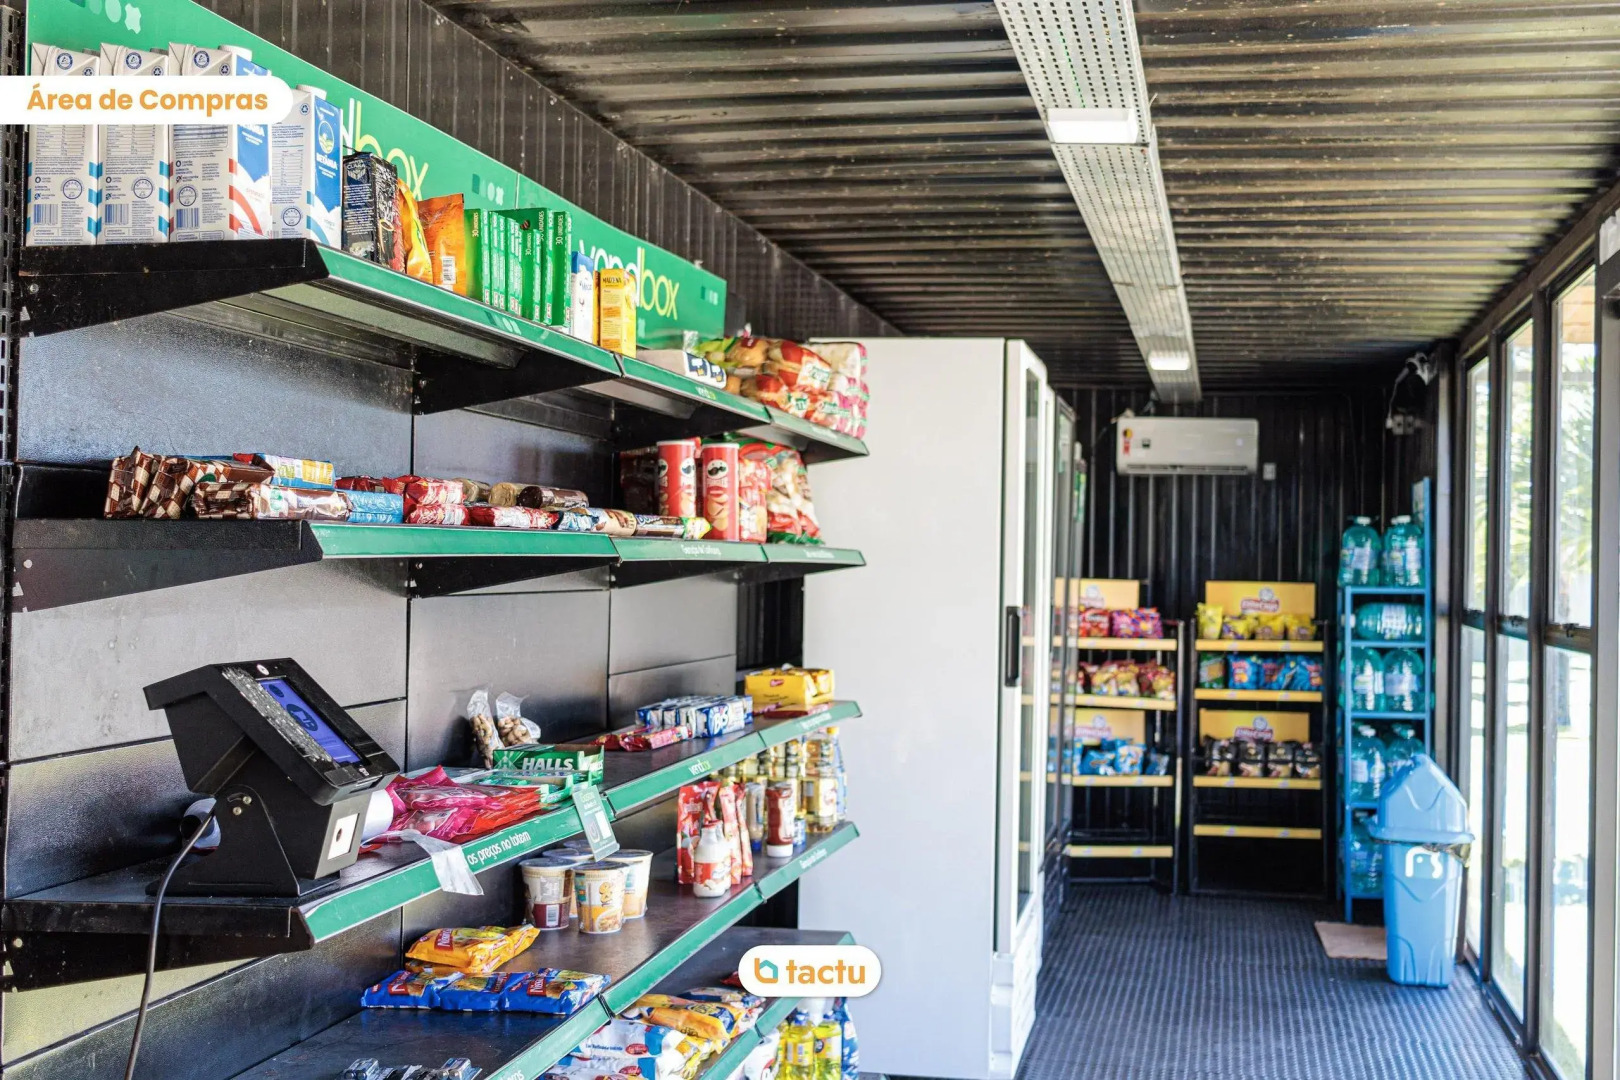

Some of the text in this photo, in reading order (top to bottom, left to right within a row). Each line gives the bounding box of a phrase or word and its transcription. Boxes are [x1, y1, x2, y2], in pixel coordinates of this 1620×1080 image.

[472, 229, 479, 238] 30
[556, 236, 563, 245] 30
[522, 757, 574, 771] HALLS
[467, 831, 531, 865] os preços no totem
